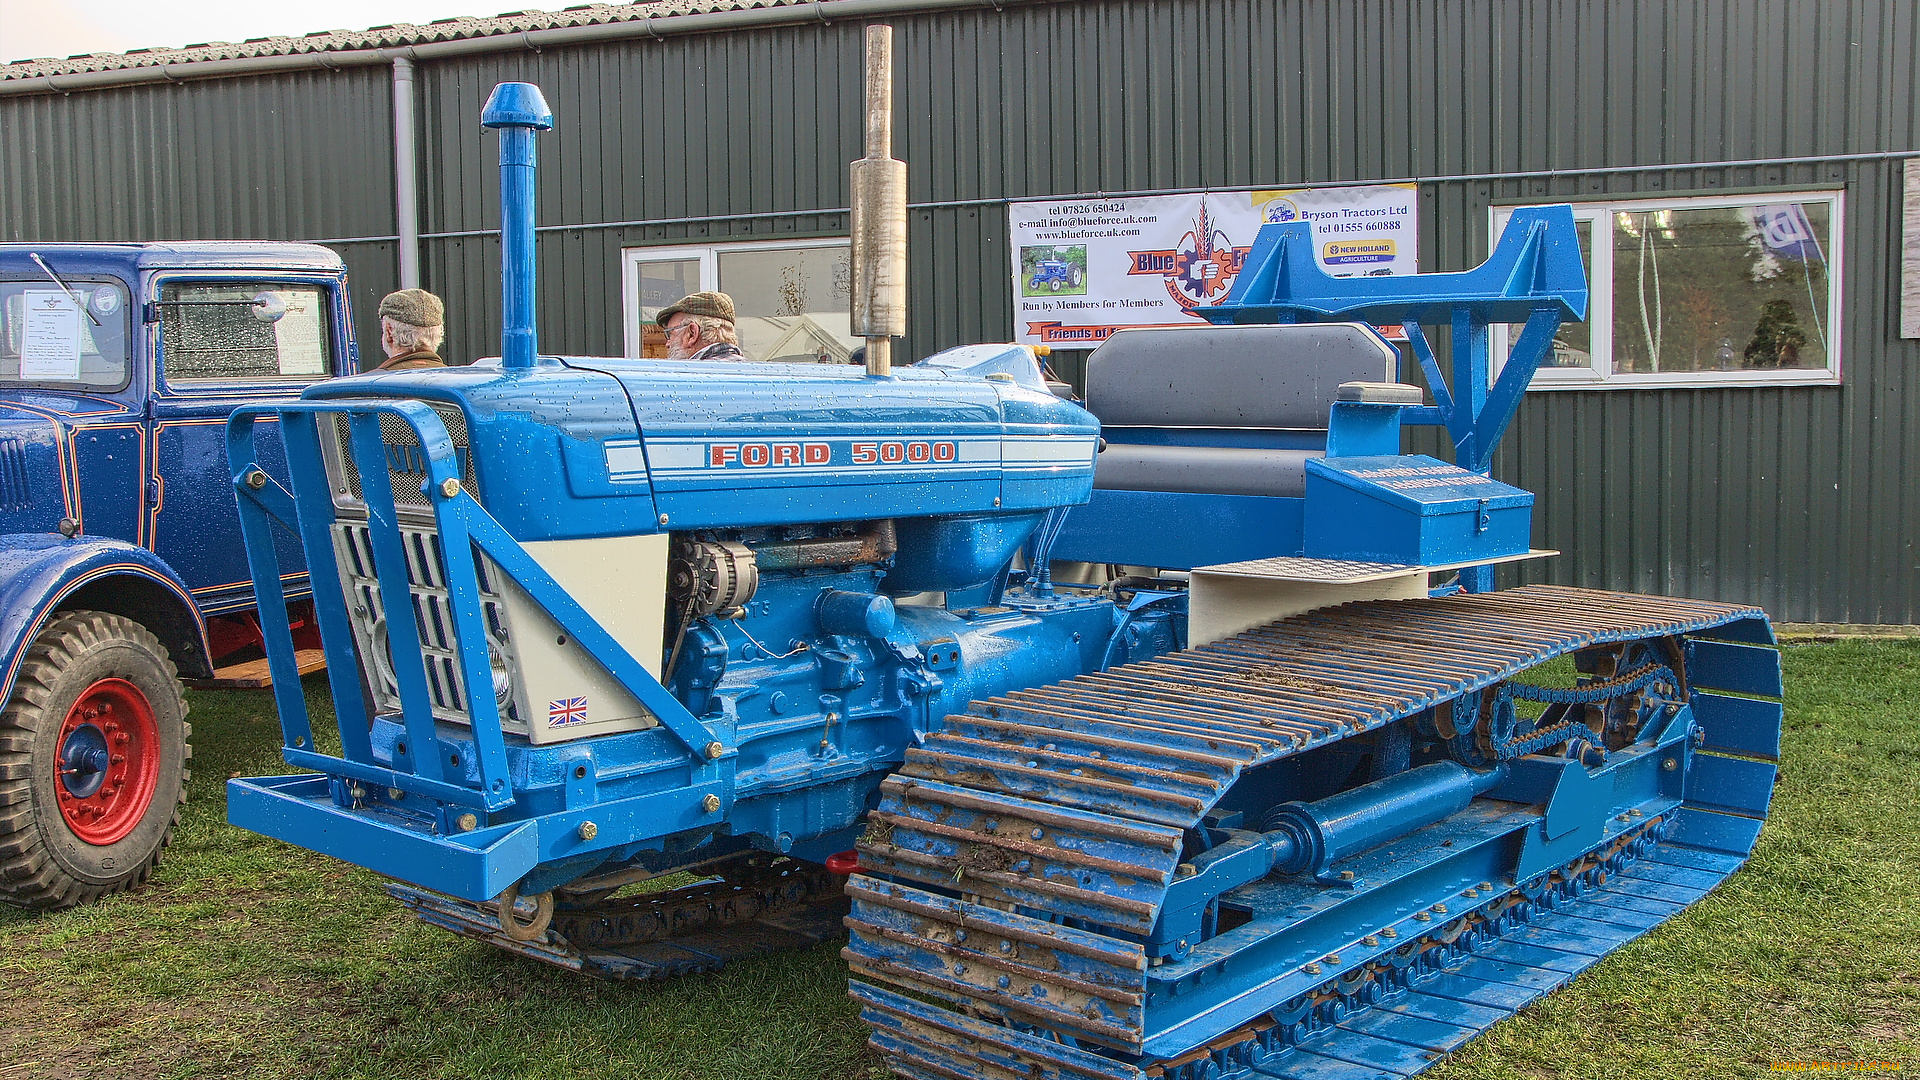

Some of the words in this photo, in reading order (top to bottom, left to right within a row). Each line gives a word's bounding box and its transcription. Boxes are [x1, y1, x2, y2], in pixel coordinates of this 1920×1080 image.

[1049, 206, 1060, 216] tel
[1063, 204, 1090, 215] 07826
[1093, 203, 1125, 213] 650424
[1301, 210, 1338, 222] Bryson
[1341, 207, 1386, 218] Tractors
[1389, 205, 1408, 215] Ltd
[1018, 219, 1047, 229] e-mail
[1049, 215, 1157, 229] info@blueforce.uk.com
[1319, 224, 1331, 234] tel
[1333, 222, 1363, 233] 01555
[1366, 221, 1401, 231] 660888
[1035, 228, 1141, 240] www.blueforce.uk.com
[1357, 245, 1390, 253] HOLLAND
[1137, 253, 1174, 271] Blue
[1340, 255, 1379, 263] AGRICULTURE
[1022, 302, 1040, 311] Run
[1042, 301, 1054, 312] by
[1056, 300, 1100, 310] Members
[1102, 299, 1117, 309] for
[1119, 298, 1164, 308] Members
[1049, 329, 1091, 339] Friends
[1095, 328, 1108, 338] of
[709, 442, 831, 468] FORD
[851, 441, 956, 465] 5000
